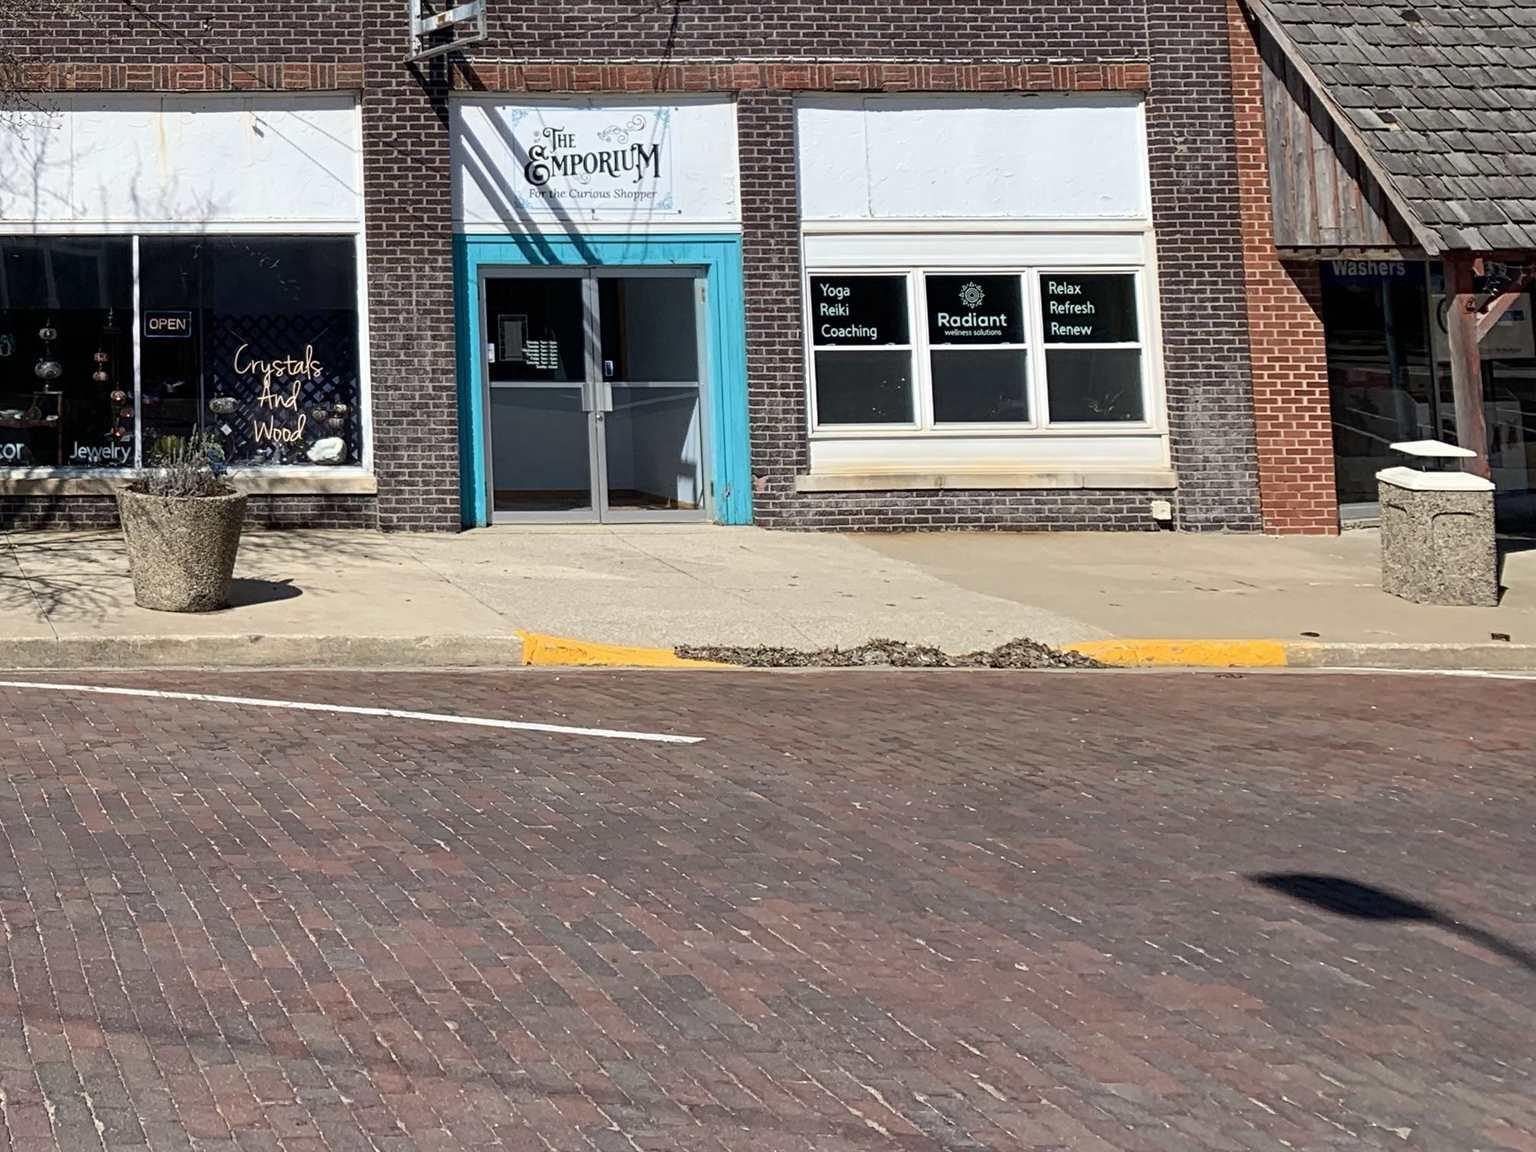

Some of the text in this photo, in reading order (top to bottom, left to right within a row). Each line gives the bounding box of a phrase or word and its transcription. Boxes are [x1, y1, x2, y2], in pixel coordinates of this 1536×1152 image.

[543, 126, 576, 153] THE
[524, 142, 661, 186] EMPORIUM
[529, 188, 658, 202] For the Curious Shopper
[1332, 259, 1406, 276] Washers
[820, 283, 850, 301] Yoga
[1048, 281, 1082, 296] Relax
[820, 303, 850, 317] Reiki
[1050, 300, 1095, 315] Refresh
[149, 318, 186, 331] OPEN
[937, 311, 1008, 328] Radiant
[821, 323, 878, 341] Coaching
[973, 328, 1003, 336] solutions
[1051, 322, 1093, 336] Renew
[233, 343, 324, 381] Crystals
[257, 379, 302, 412] And
[253, 413, 307, 443] Wood
[69, 440, 132, 464] Jewelry
